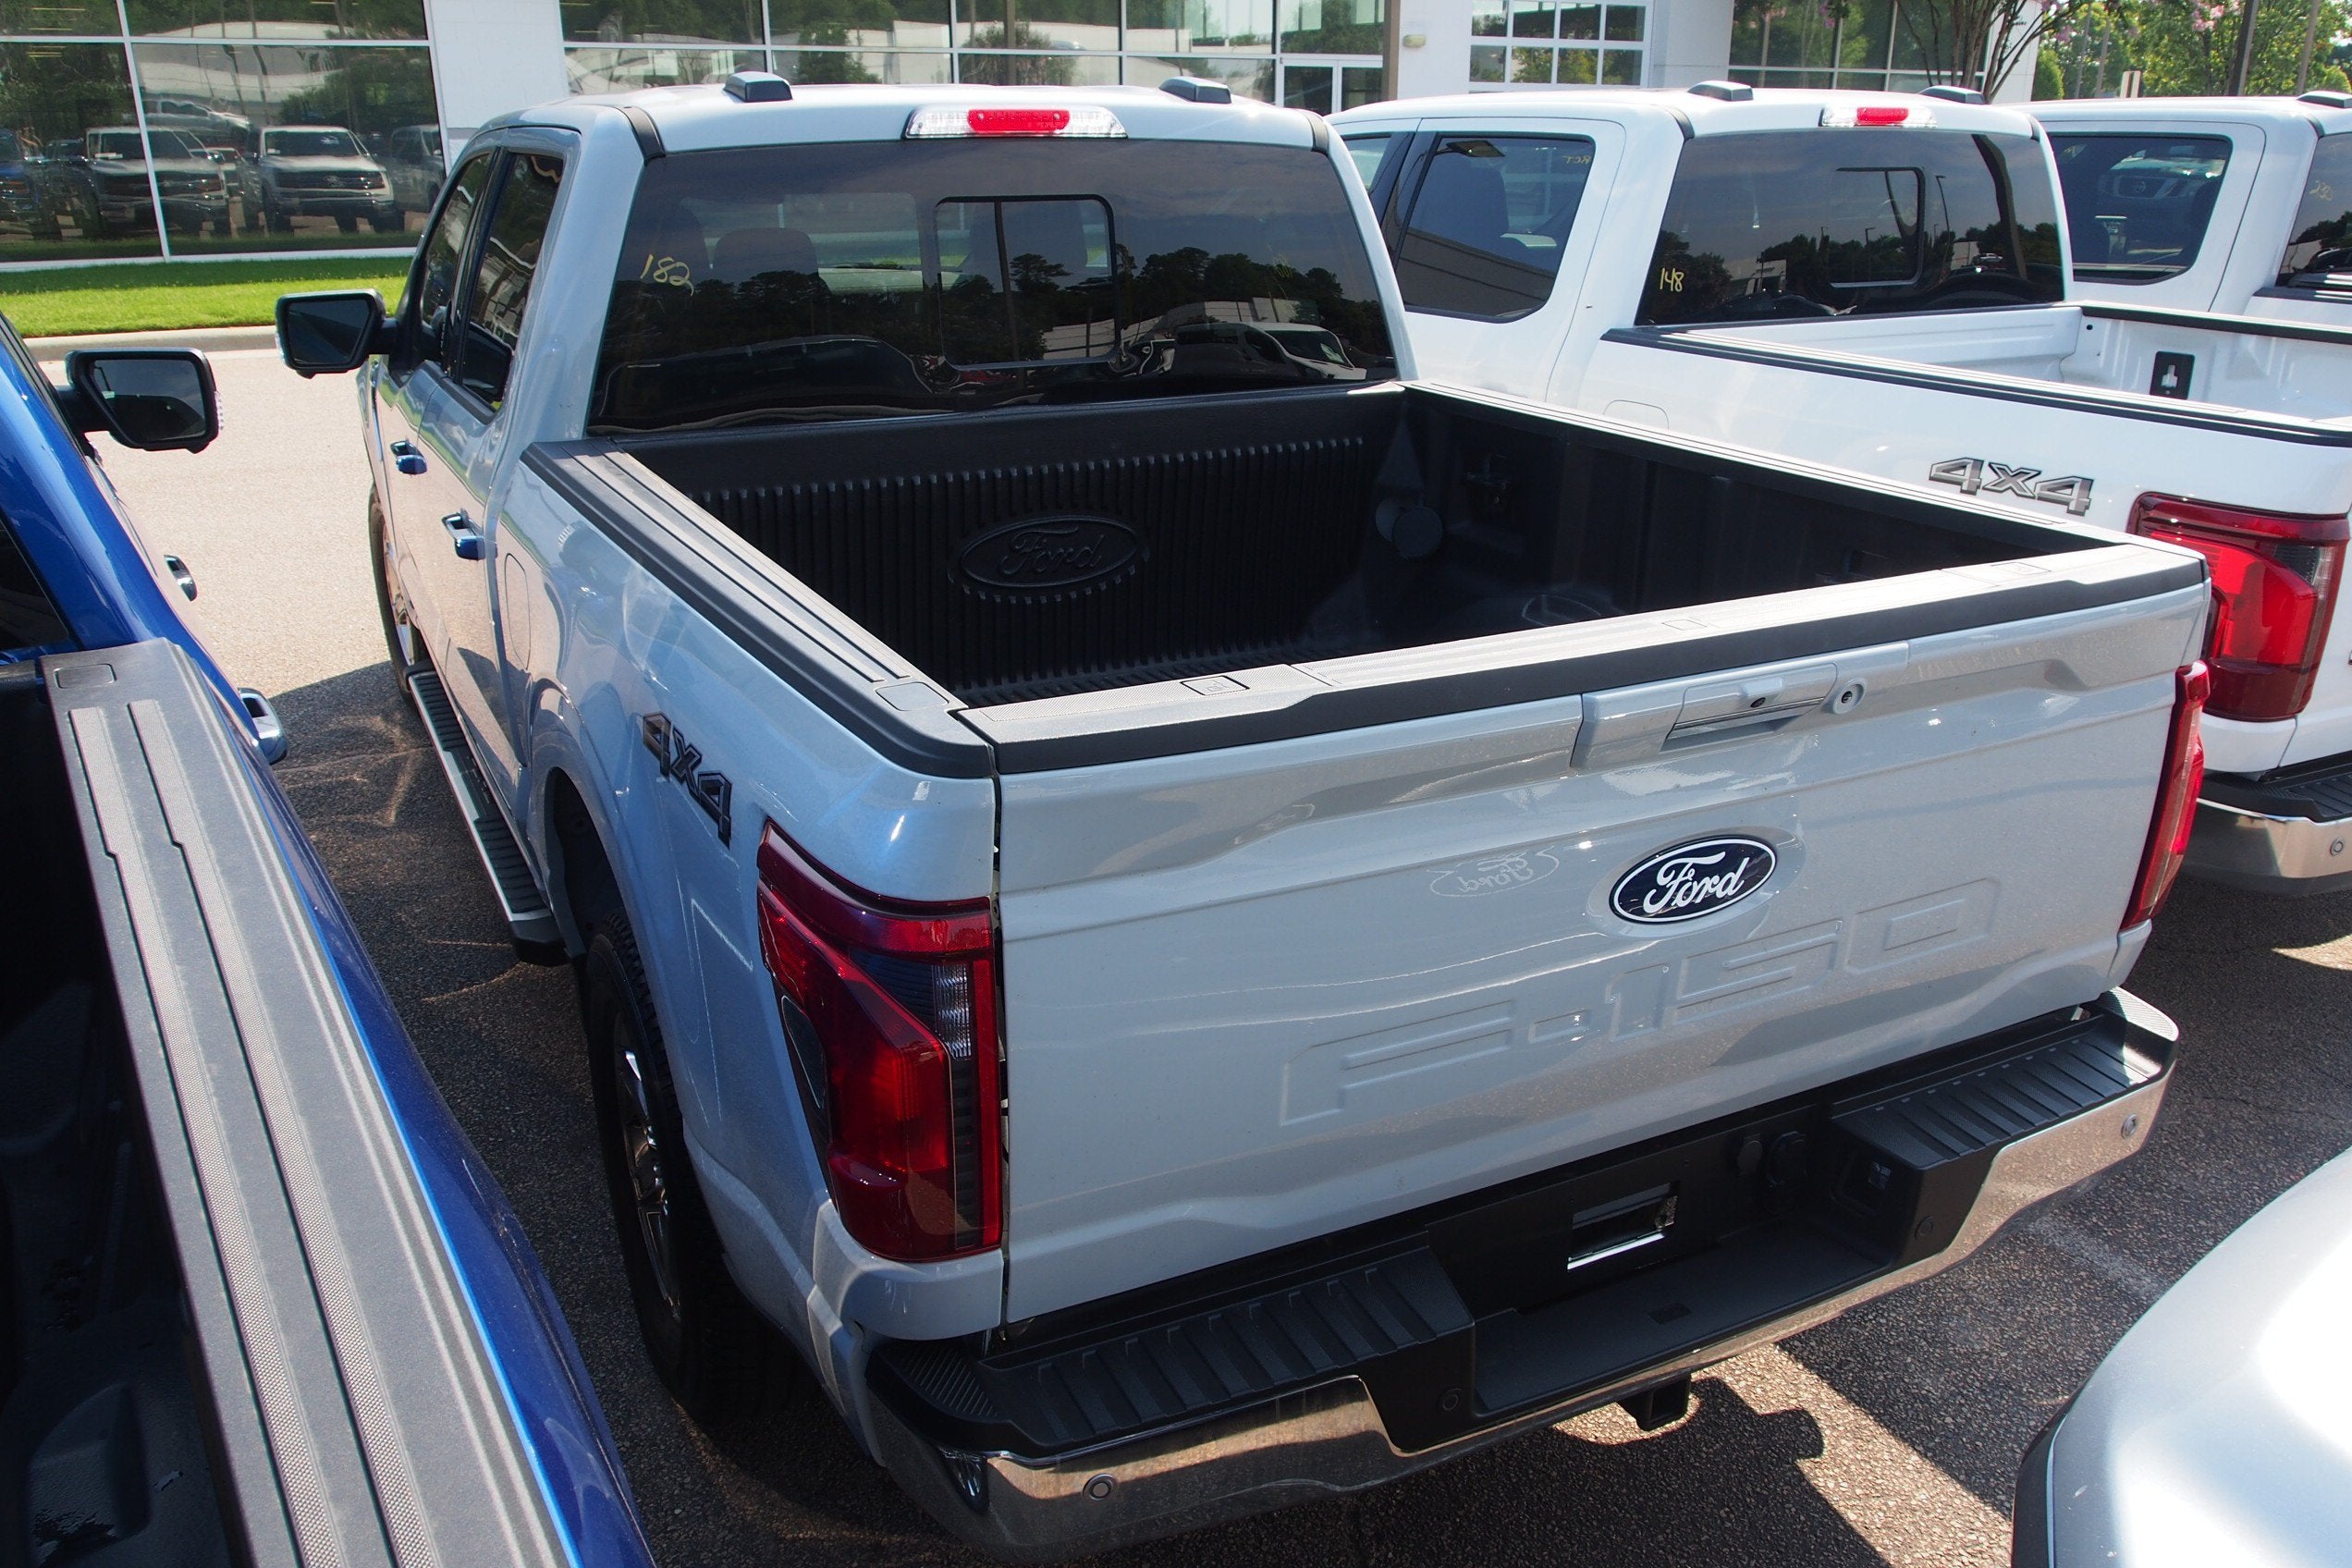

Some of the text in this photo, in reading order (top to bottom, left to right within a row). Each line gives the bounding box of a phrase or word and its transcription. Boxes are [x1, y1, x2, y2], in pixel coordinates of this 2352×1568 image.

[640, 253, 694, 297] 182
[1660, 267, 1684, 292] 148
[998, 526, 1106, 575] Ford
[1643, 851, 1750, 913] Ford
[1280, 878, 1999, 1126] F-150
